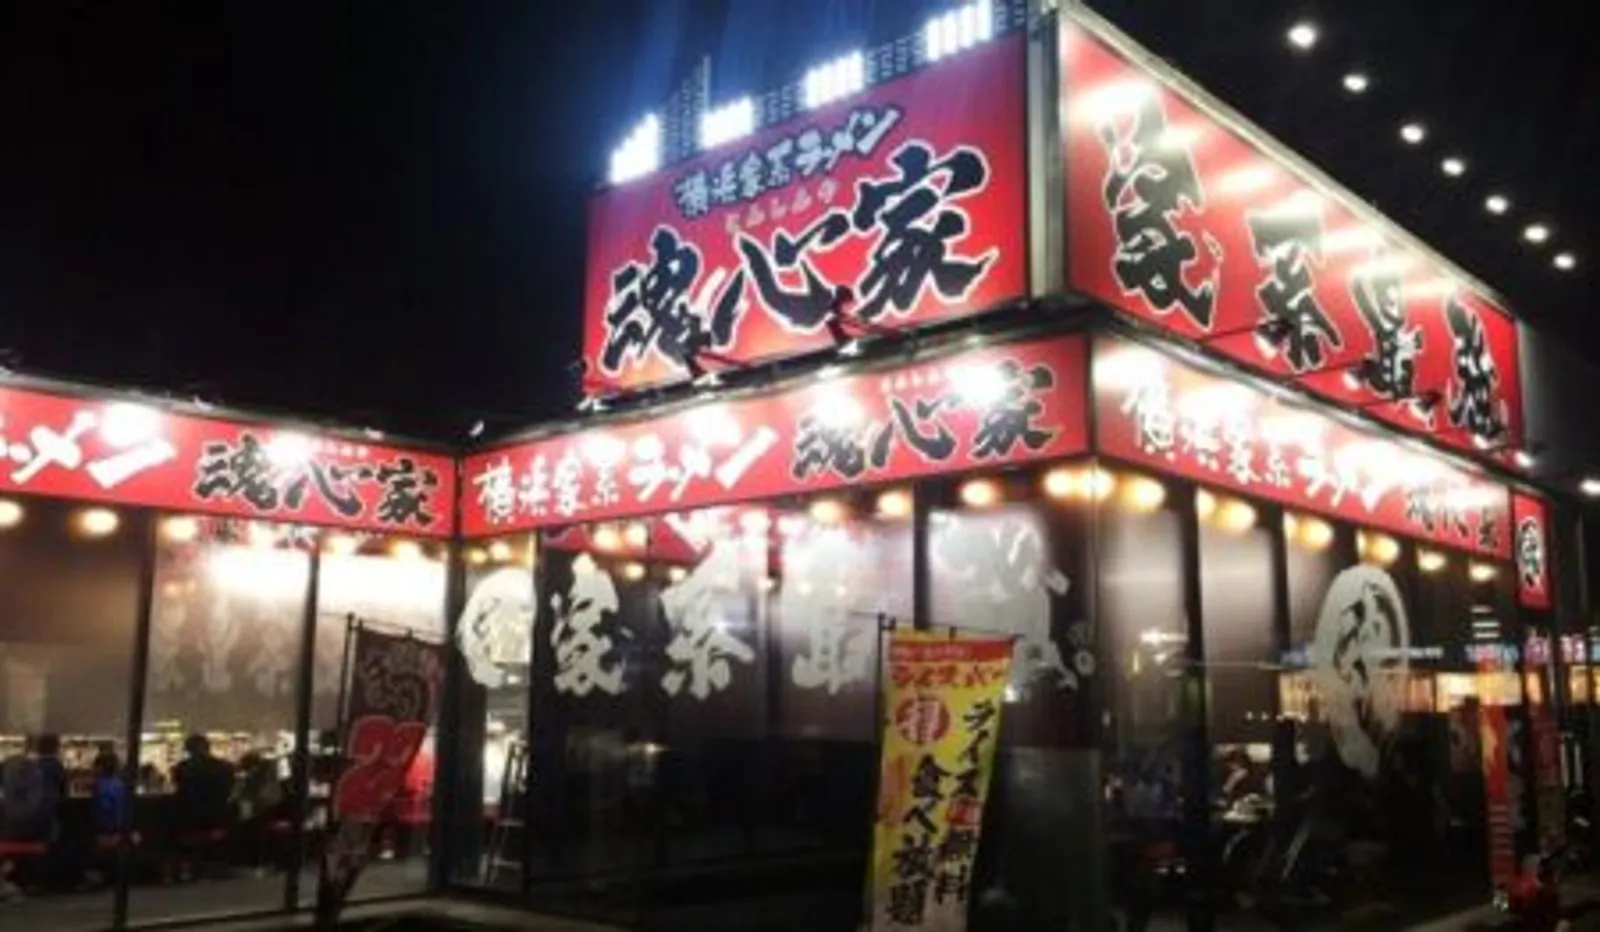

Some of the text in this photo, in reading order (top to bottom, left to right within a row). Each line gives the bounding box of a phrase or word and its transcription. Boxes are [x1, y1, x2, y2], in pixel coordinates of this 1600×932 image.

[601, 140, 1000, 374] 魂心家
[195, 428, 440, 528] 魂心家
